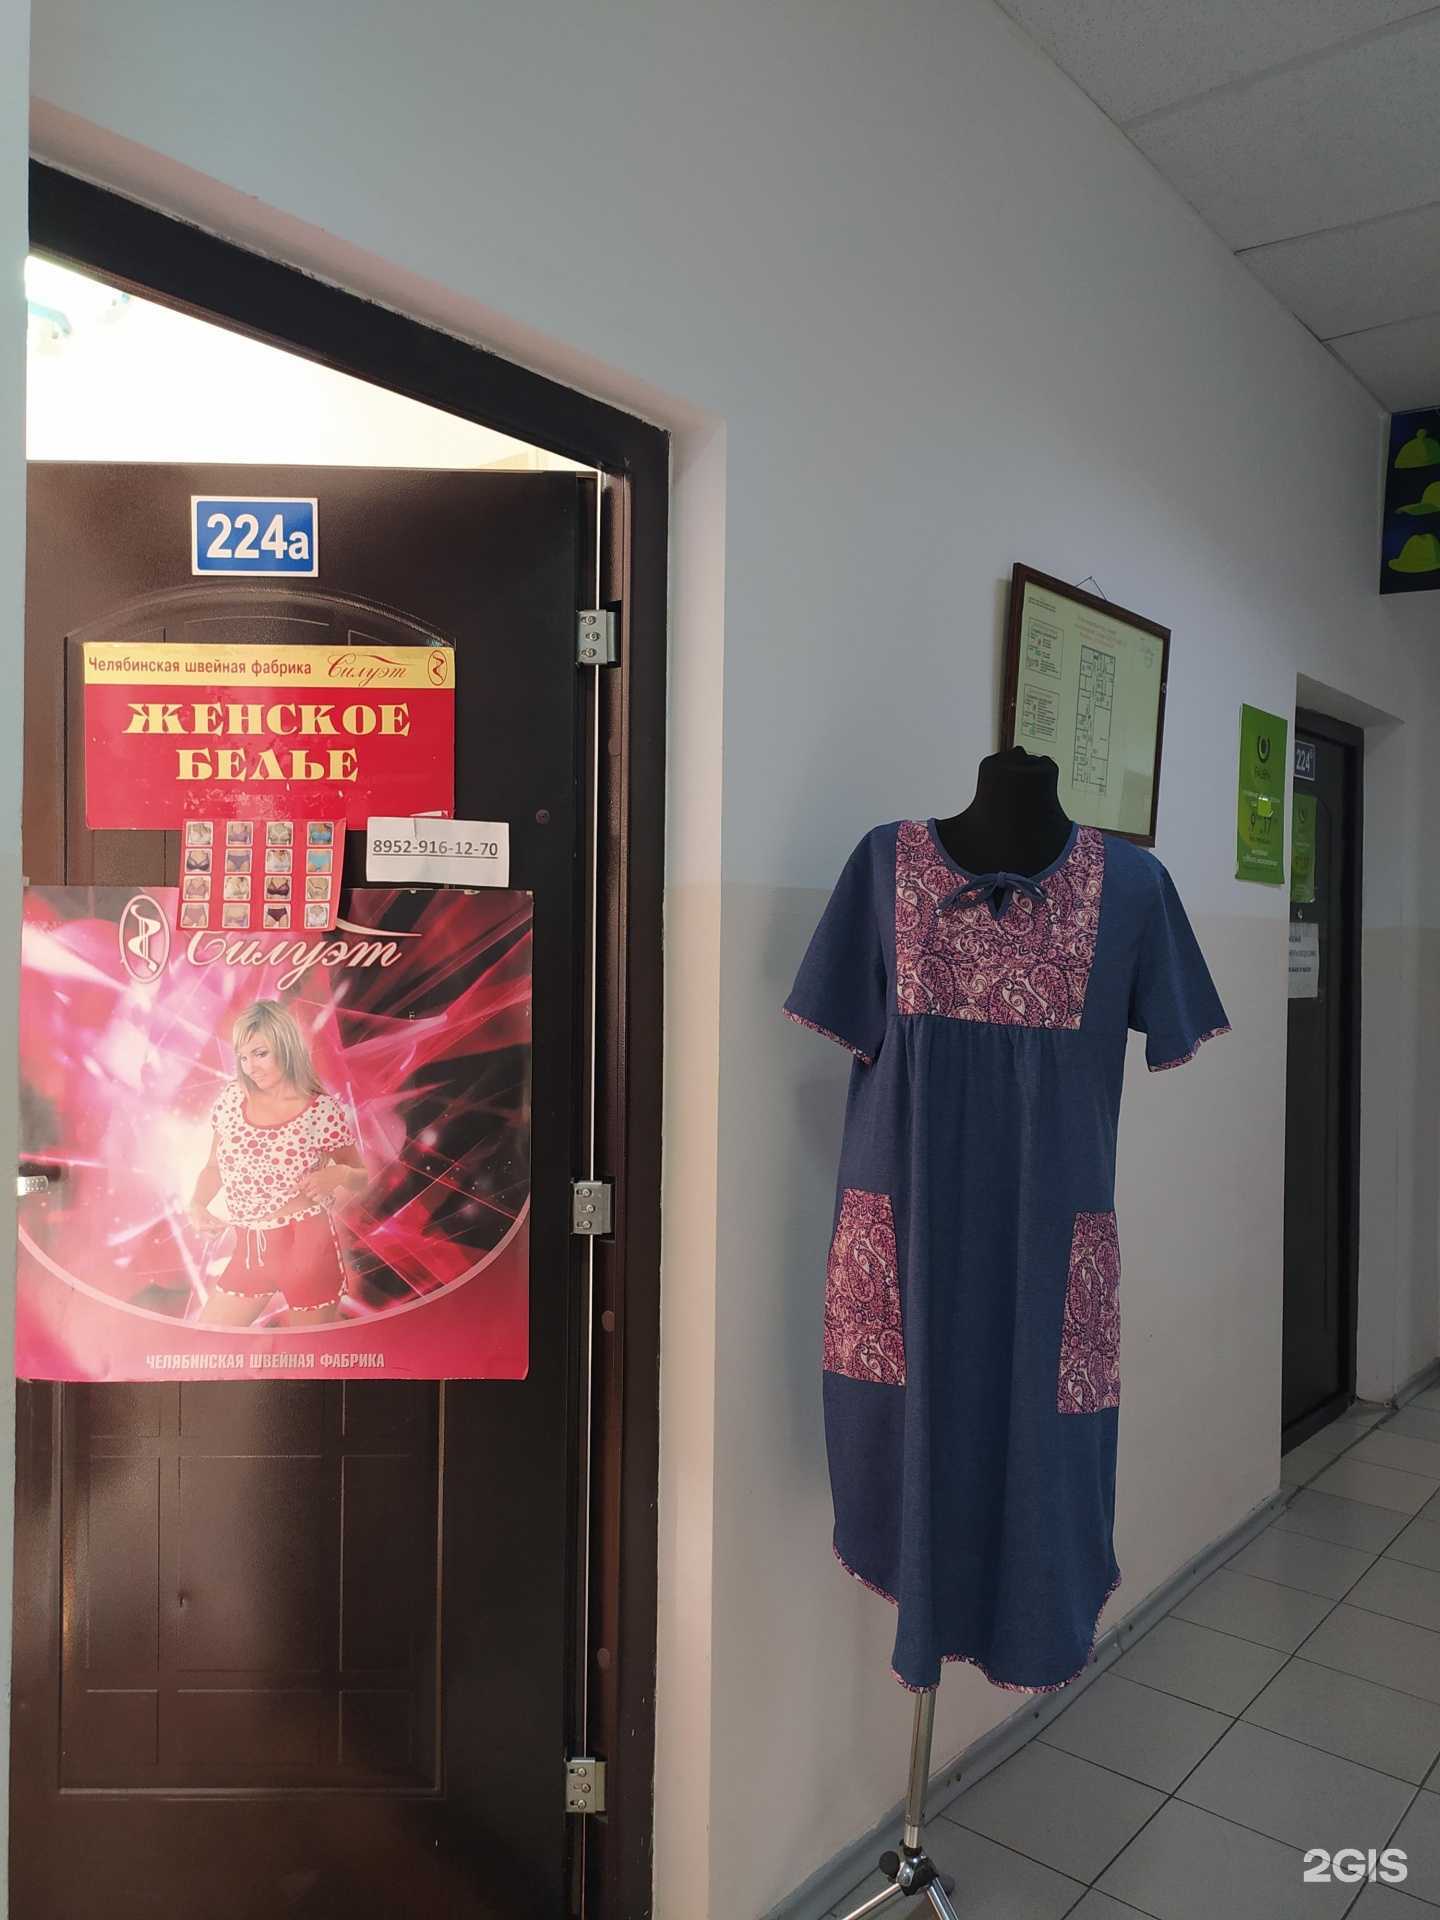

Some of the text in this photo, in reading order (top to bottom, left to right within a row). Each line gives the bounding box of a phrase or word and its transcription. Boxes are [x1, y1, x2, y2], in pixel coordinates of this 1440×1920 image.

[206, 513, 309, 560] 224а
[89, 652, 409, 687] Челябинская швейная фабрика Силуэт
[122, 702, 411, 737] ЖЕНСКОЕ
[176, 747, 359, 782] БЕЛЬЕ
[372, 839, 499, 858] 8952-916-12-70
[146, 1351, 385, 1369] ЧЕЛЯБИНСКАЯ ШВЕЙНАЯ ФАБРИКА
